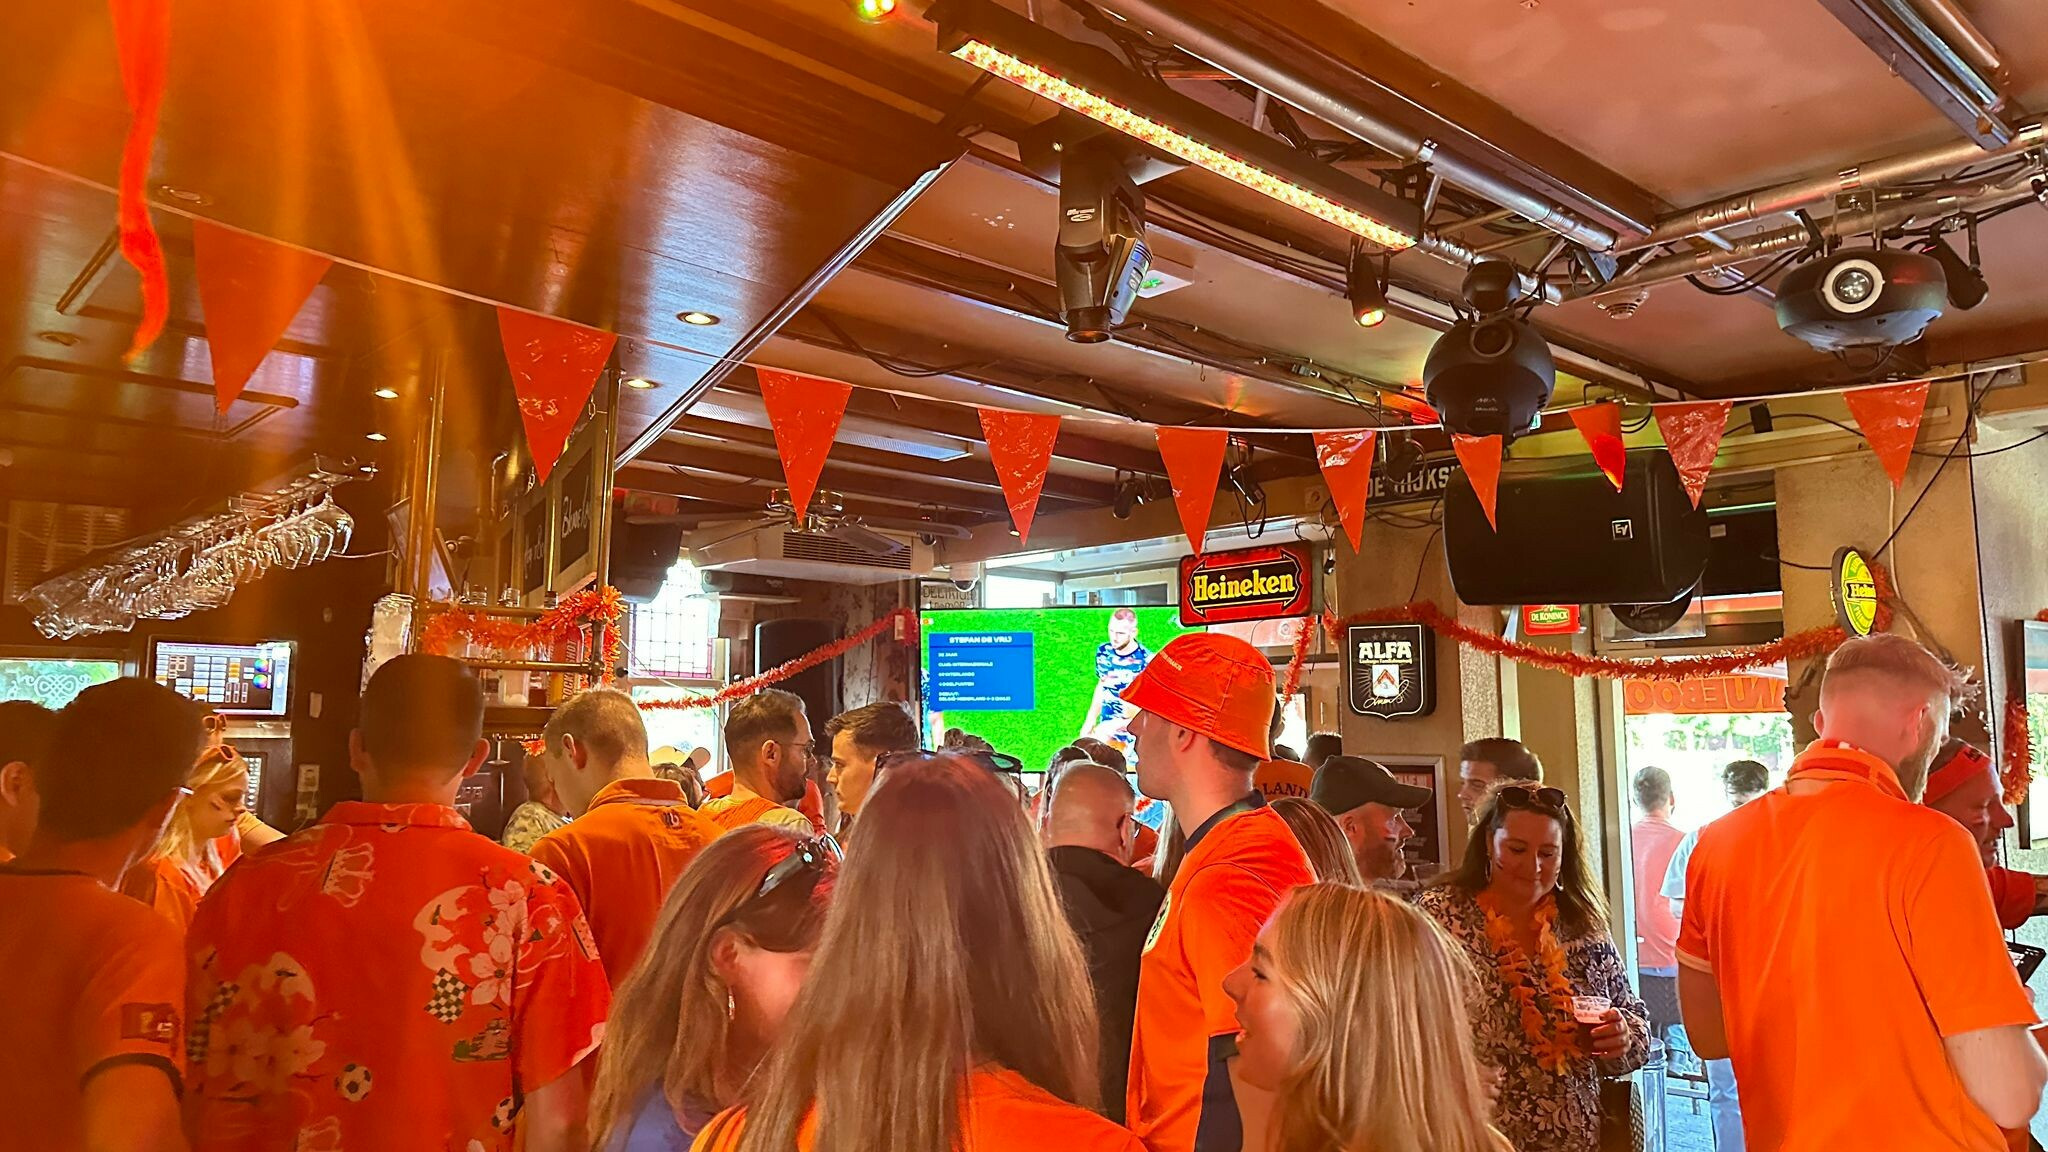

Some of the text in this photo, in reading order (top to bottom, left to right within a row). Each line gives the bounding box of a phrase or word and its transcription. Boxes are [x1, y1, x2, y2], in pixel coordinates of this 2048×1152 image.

[1193, 569, 1296, 602] Heineken
[1540, 611, 1568, 621] KONINCK
[949, 636, 980, 644] STEFAN
[993, 635, 1013, 643] VRIJ
[1359, 641, 1412, 659] ALFA
